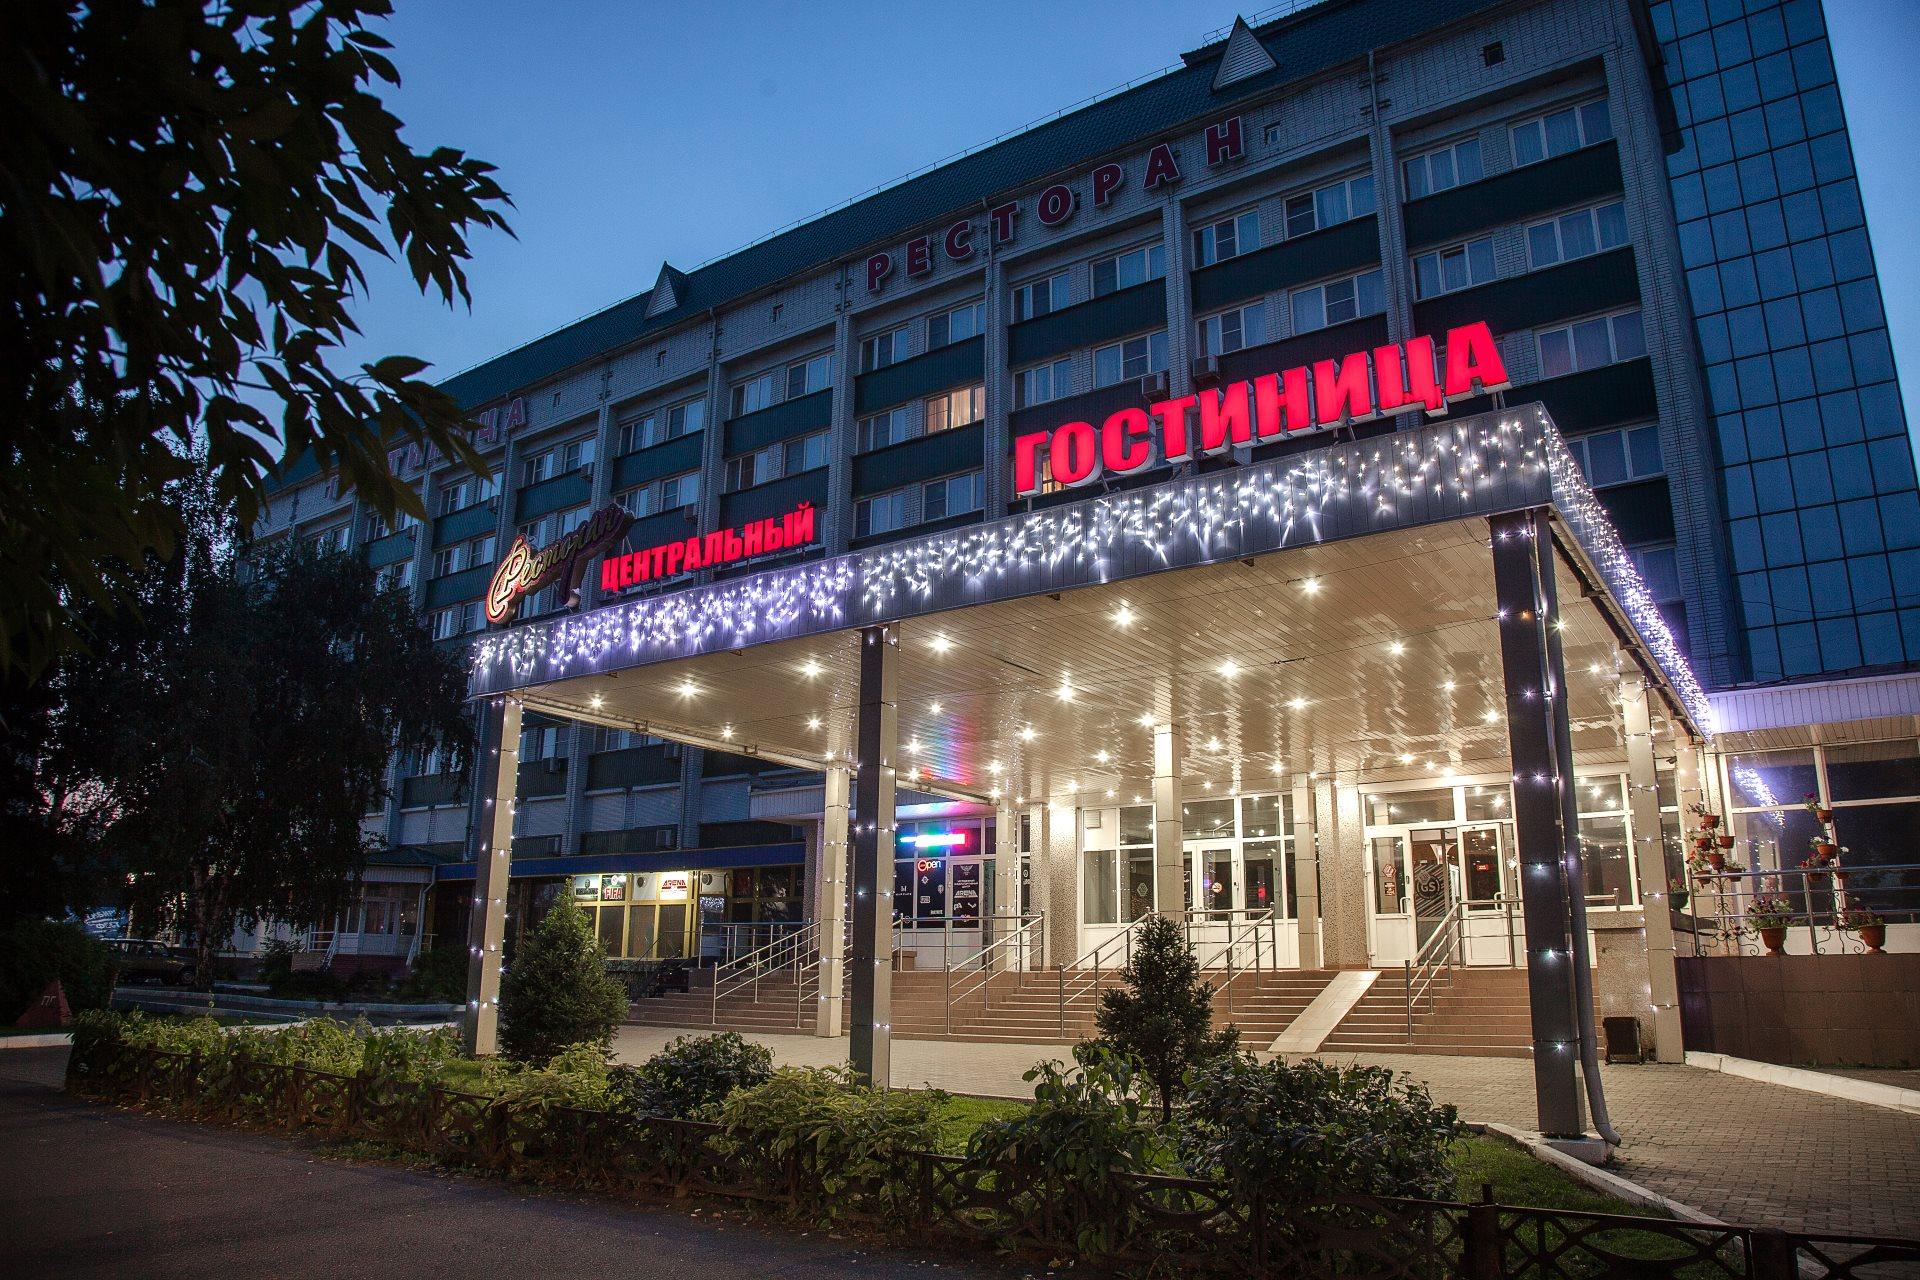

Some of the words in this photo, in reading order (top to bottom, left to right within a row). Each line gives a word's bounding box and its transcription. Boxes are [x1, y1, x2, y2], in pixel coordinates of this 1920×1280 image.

[866, 116, 1243, 292] РЕСТОРАН
[1015, 321, 1511, 497] ГОСТИНИЦА
[601, 502, 814, 592] ЦЕНТРАЛЬНЫЙ
[917, 860, 941, 872] Open
[662, 880, 686, 888] ARENA
[1421, 881, 1436, 892] GS
[604, 887, 623, 900] FIFA
